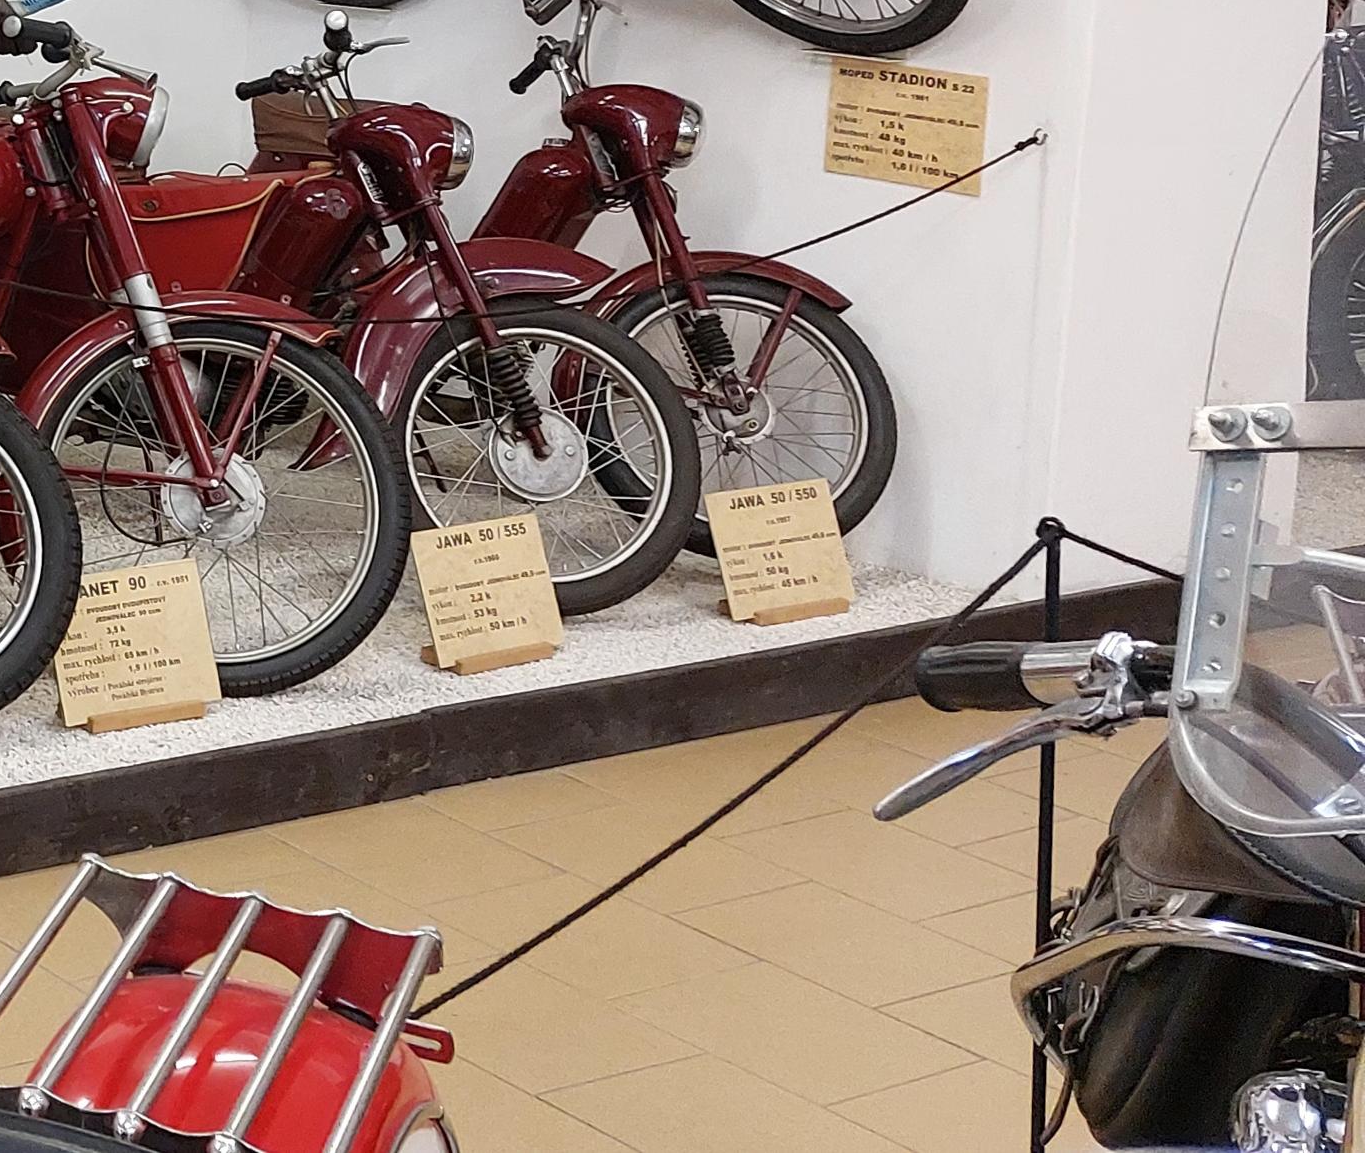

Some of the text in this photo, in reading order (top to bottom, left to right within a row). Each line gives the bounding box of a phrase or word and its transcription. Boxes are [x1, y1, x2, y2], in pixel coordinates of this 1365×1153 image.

[839, 68, 975, 94] MOPED STADION 22
[880, 120, 895, 130] 1,5
[894, 135, 906, 145] kg
[908, 151, 923, 161] km
[922, 166, 940, 176] 100
[729, 487, 817, 510] JAWA 50 550
[436, 523, 527, 549] JAWA 50 555
[779, 566, 789, 575] kg
[79, 576, 146, 599] ANET 90
[486, 607, 498, 616] kg
[502, 619, 515, 628] km
[121, 638, 131, 647] kg
[169, 658, 181, 666] km
